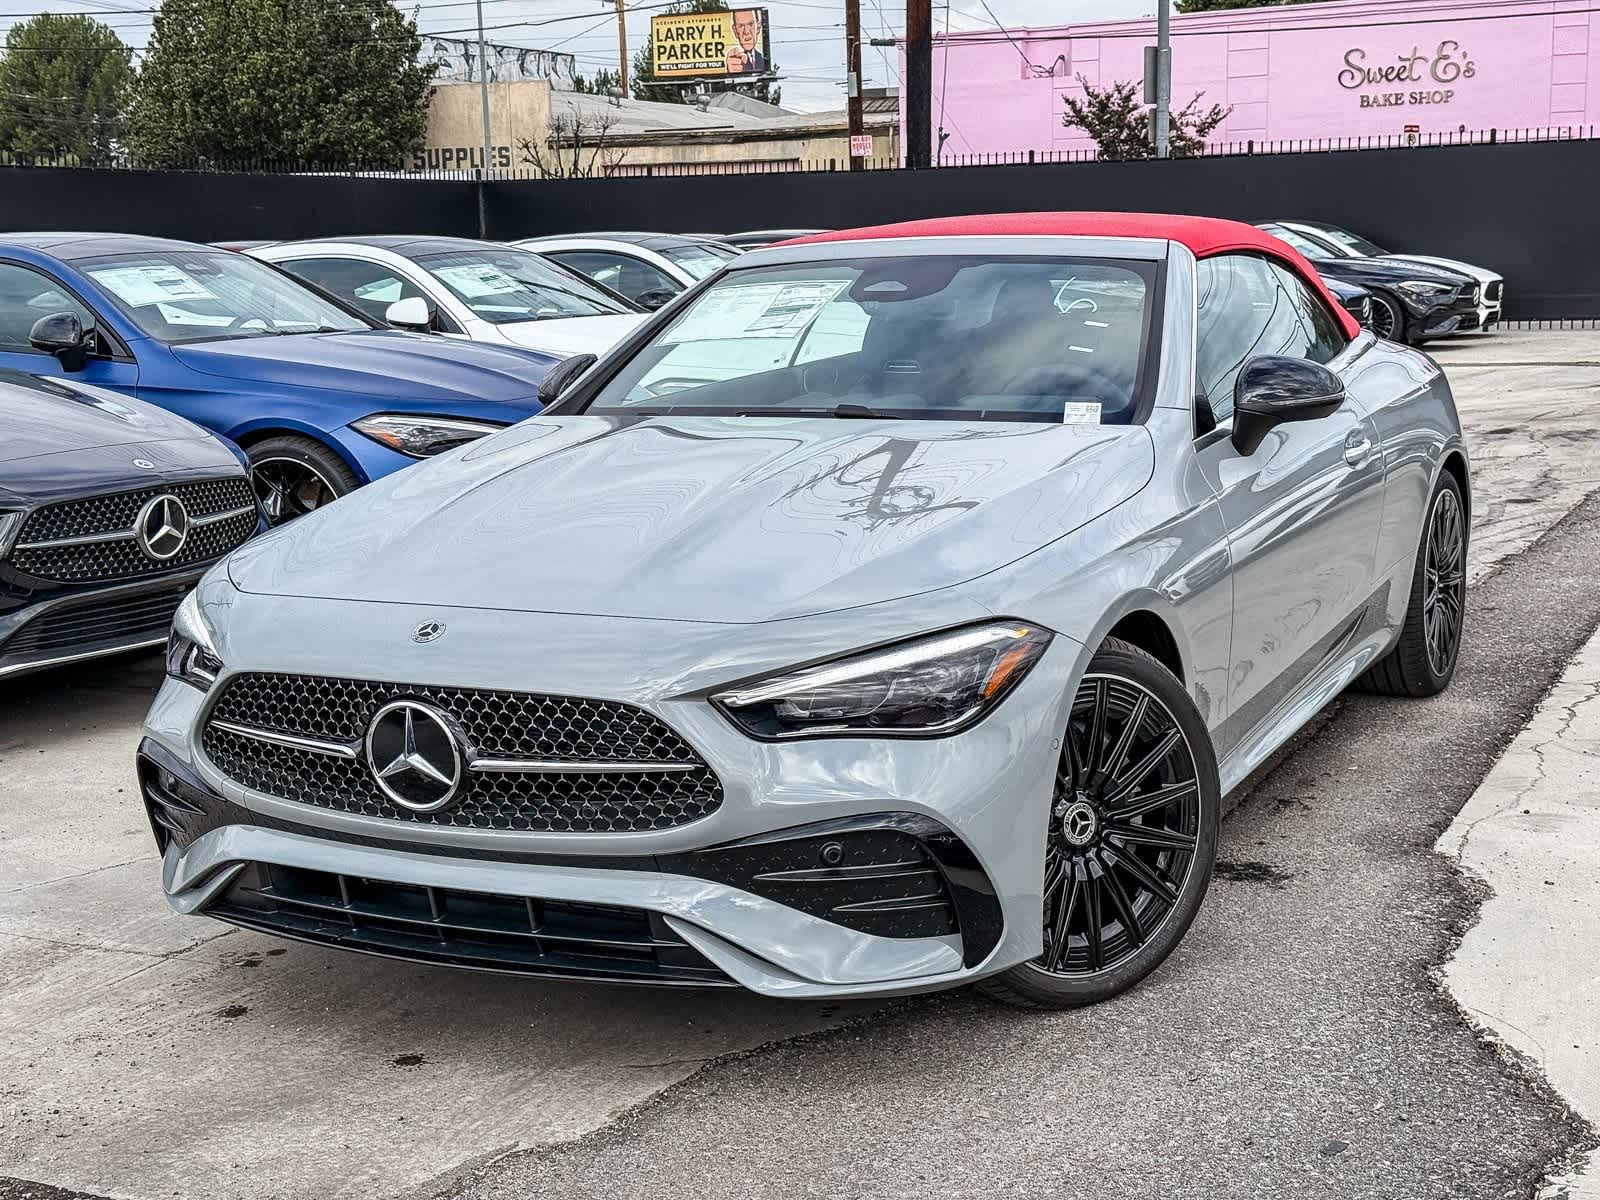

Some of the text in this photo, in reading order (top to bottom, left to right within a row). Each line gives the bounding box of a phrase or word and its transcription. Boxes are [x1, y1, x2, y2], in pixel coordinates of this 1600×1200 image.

[656, 24, 725, 42] LARRY H.
[657, 42, 725, 61] PARKER
[1338, 40, 1475, 89] Sweet E's
[1359, 89, 1454, 108] BAKE SHOP
